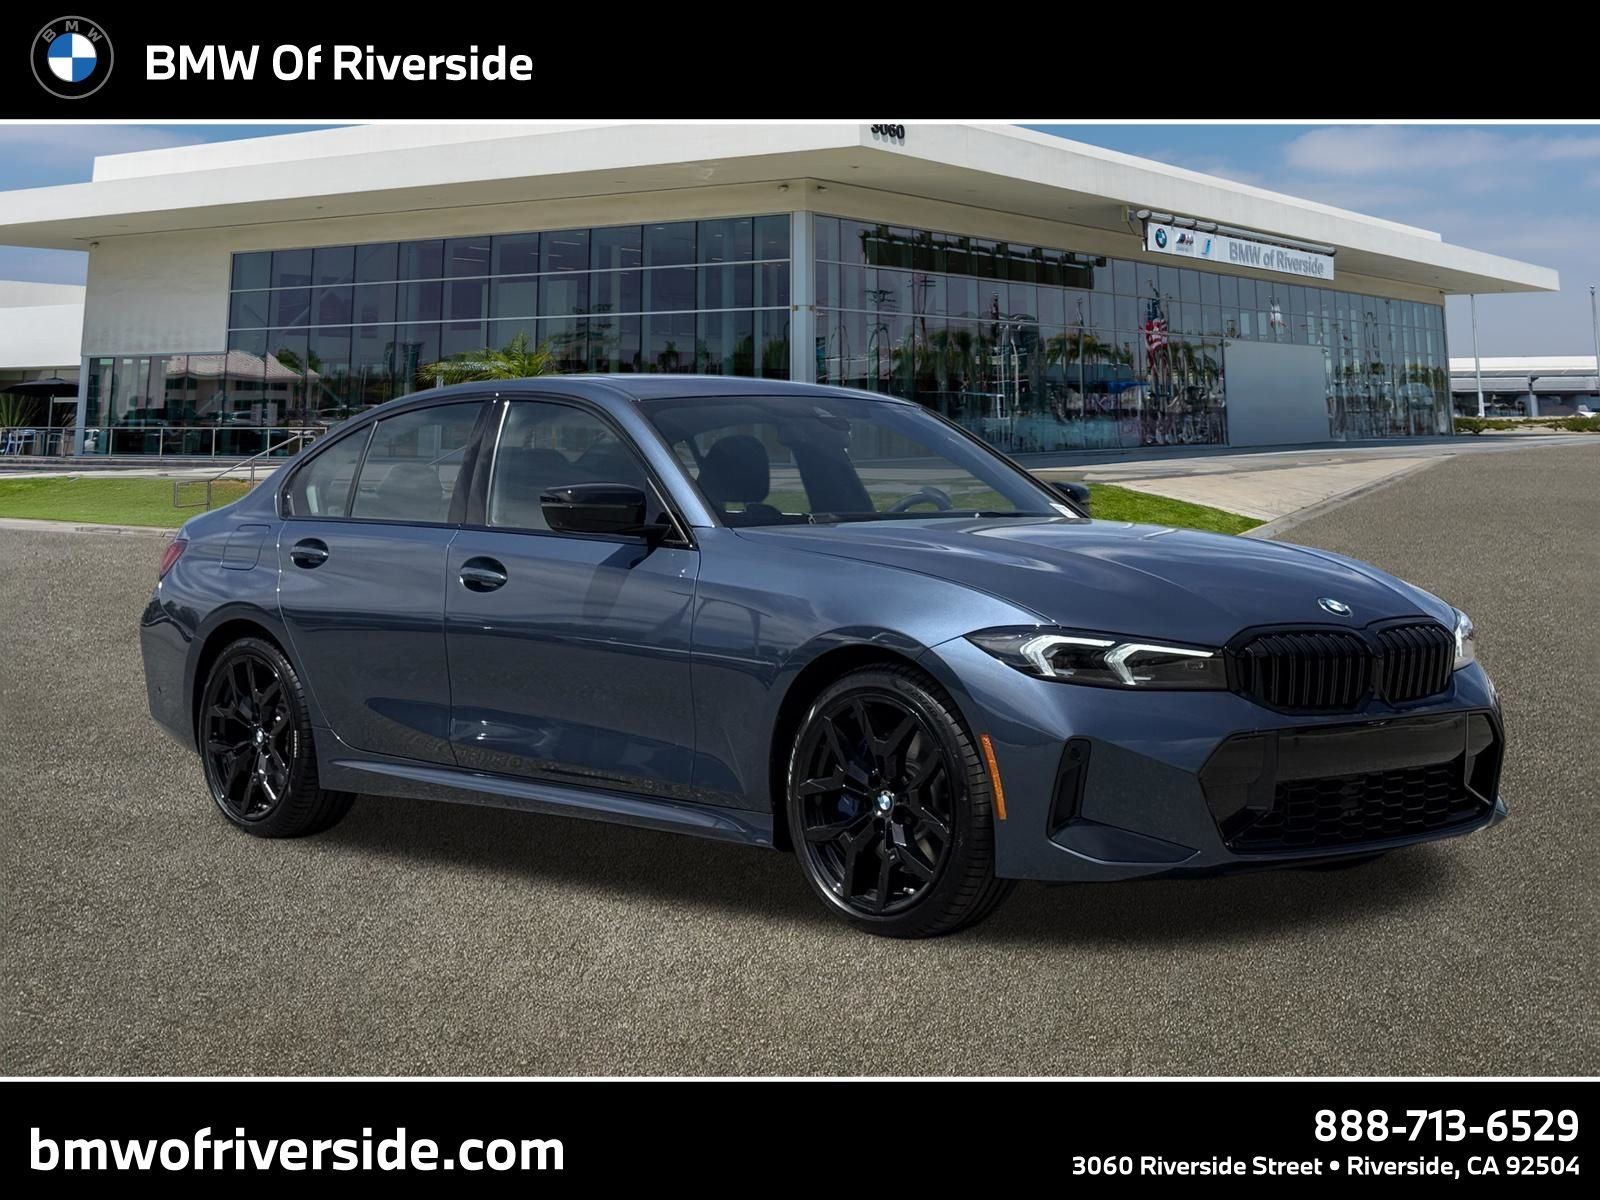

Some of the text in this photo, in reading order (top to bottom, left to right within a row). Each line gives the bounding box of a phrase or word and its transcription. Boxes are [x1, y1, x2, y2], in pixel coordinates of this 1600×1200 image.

[1229, 241, 1260, 265] BMW
[1263, 249, 1275, 268] of
[1276, 251, 1324, 275] Riverside
